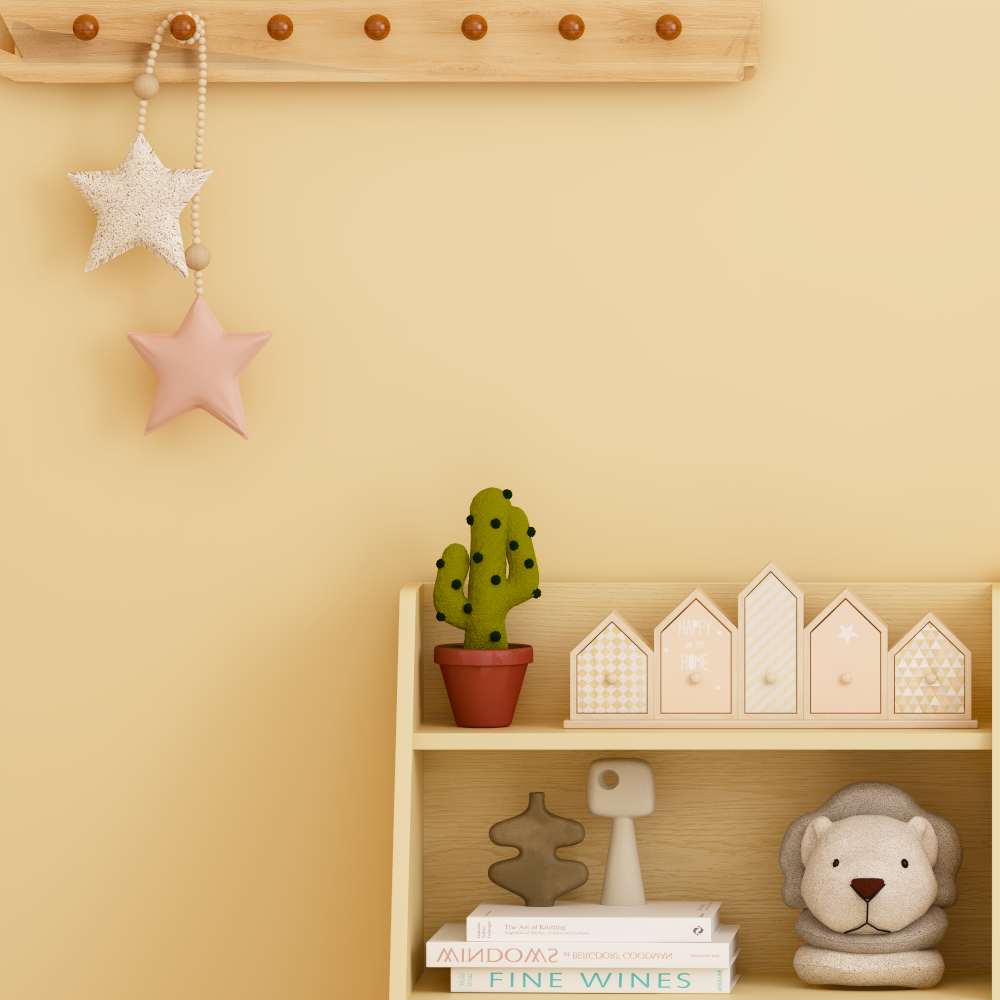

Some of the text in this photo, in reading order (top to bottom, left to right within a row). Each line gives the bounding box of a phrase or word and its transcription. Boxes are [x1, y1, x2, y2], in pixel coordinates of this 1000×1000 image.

[678, 619, 713, 636] HAPPY
[685, 640, 705, 649] IN MY
[681, 653, 708, 671] HOME
[490, 972, 562, 988] FINE
[580, 972, 691, 989] WINES
